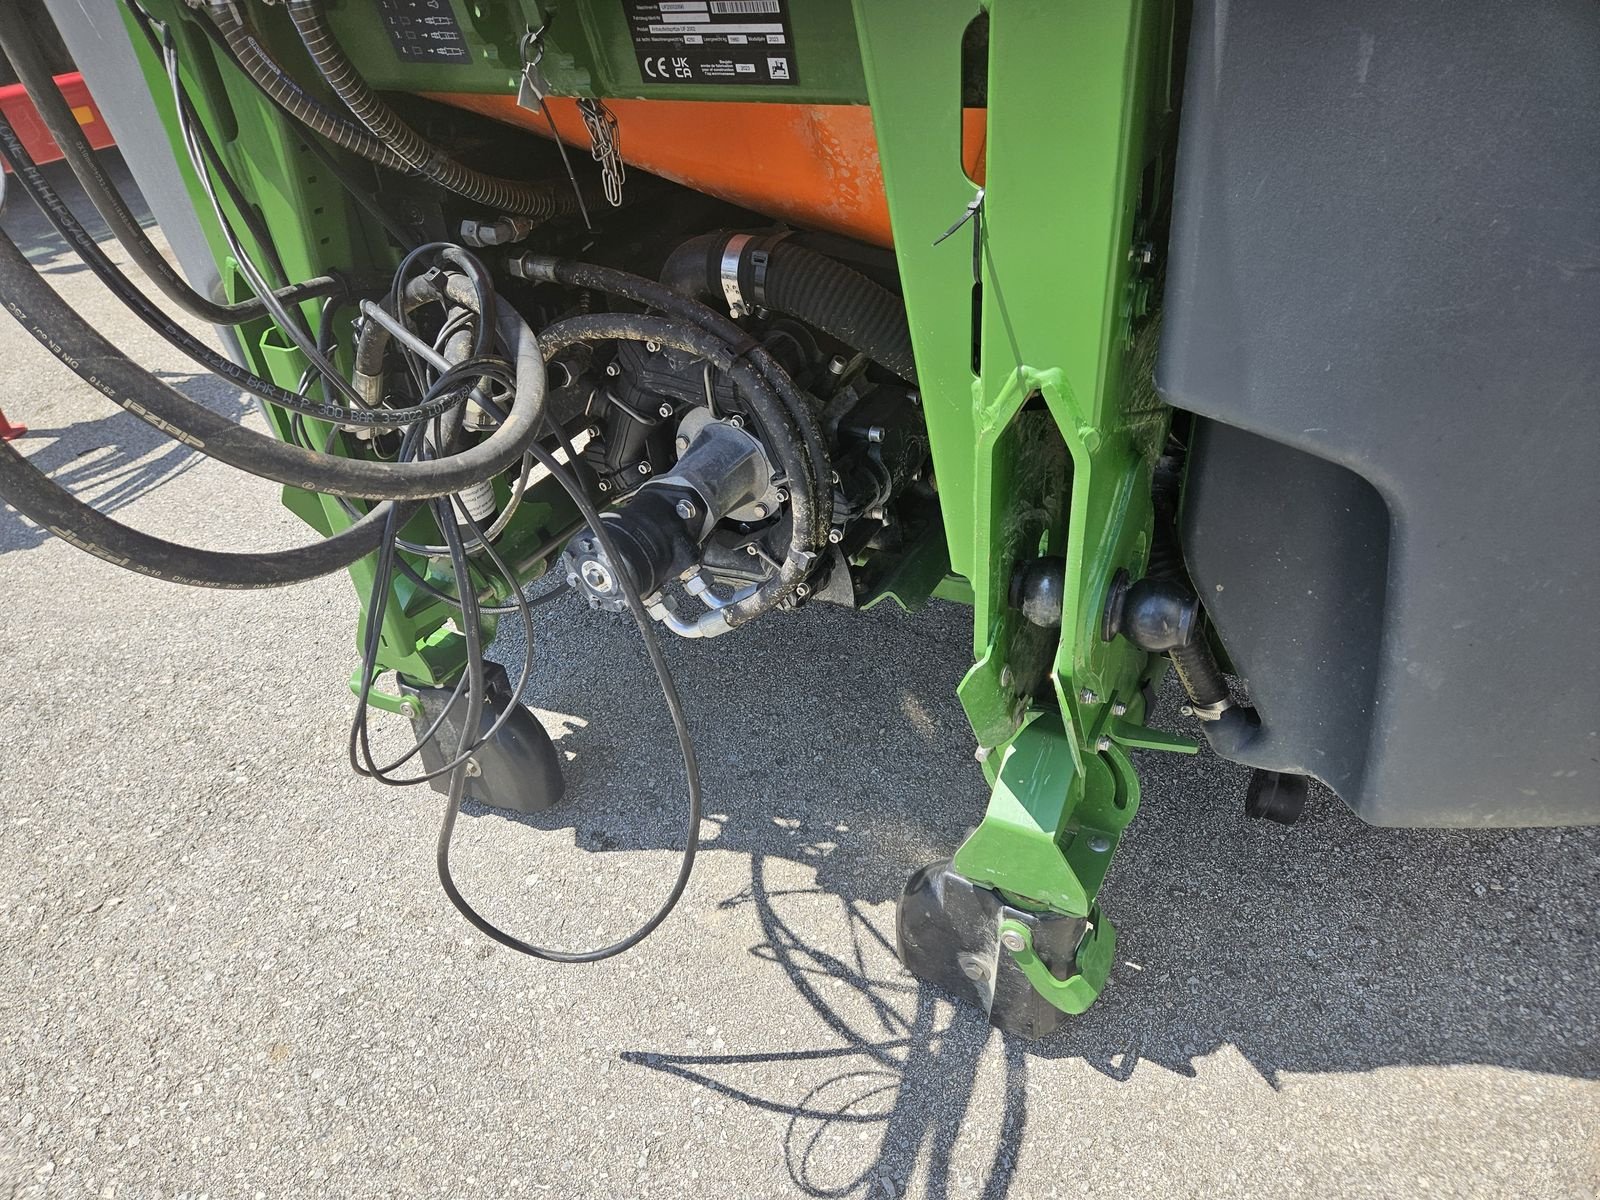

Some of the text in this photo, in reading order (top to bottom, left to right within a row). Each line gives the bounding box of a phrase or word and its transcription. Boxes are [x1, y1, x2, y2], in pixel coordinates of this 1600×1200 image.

[645, 57, 670, 78] CE
[672, 57, 690, 68] UK
[675, 68, 693, 78] CA
[49, 339, 62, 354] EN
[61, 352, 81, 370] DIN
[89, 376, 117, 397] 29-10
[246, 377, 277, 396] BAR
[350, 410, 375, 423] BAR
[381, 409, 423, 423] 3-2022
[171, 575, 190, 584] DIN
